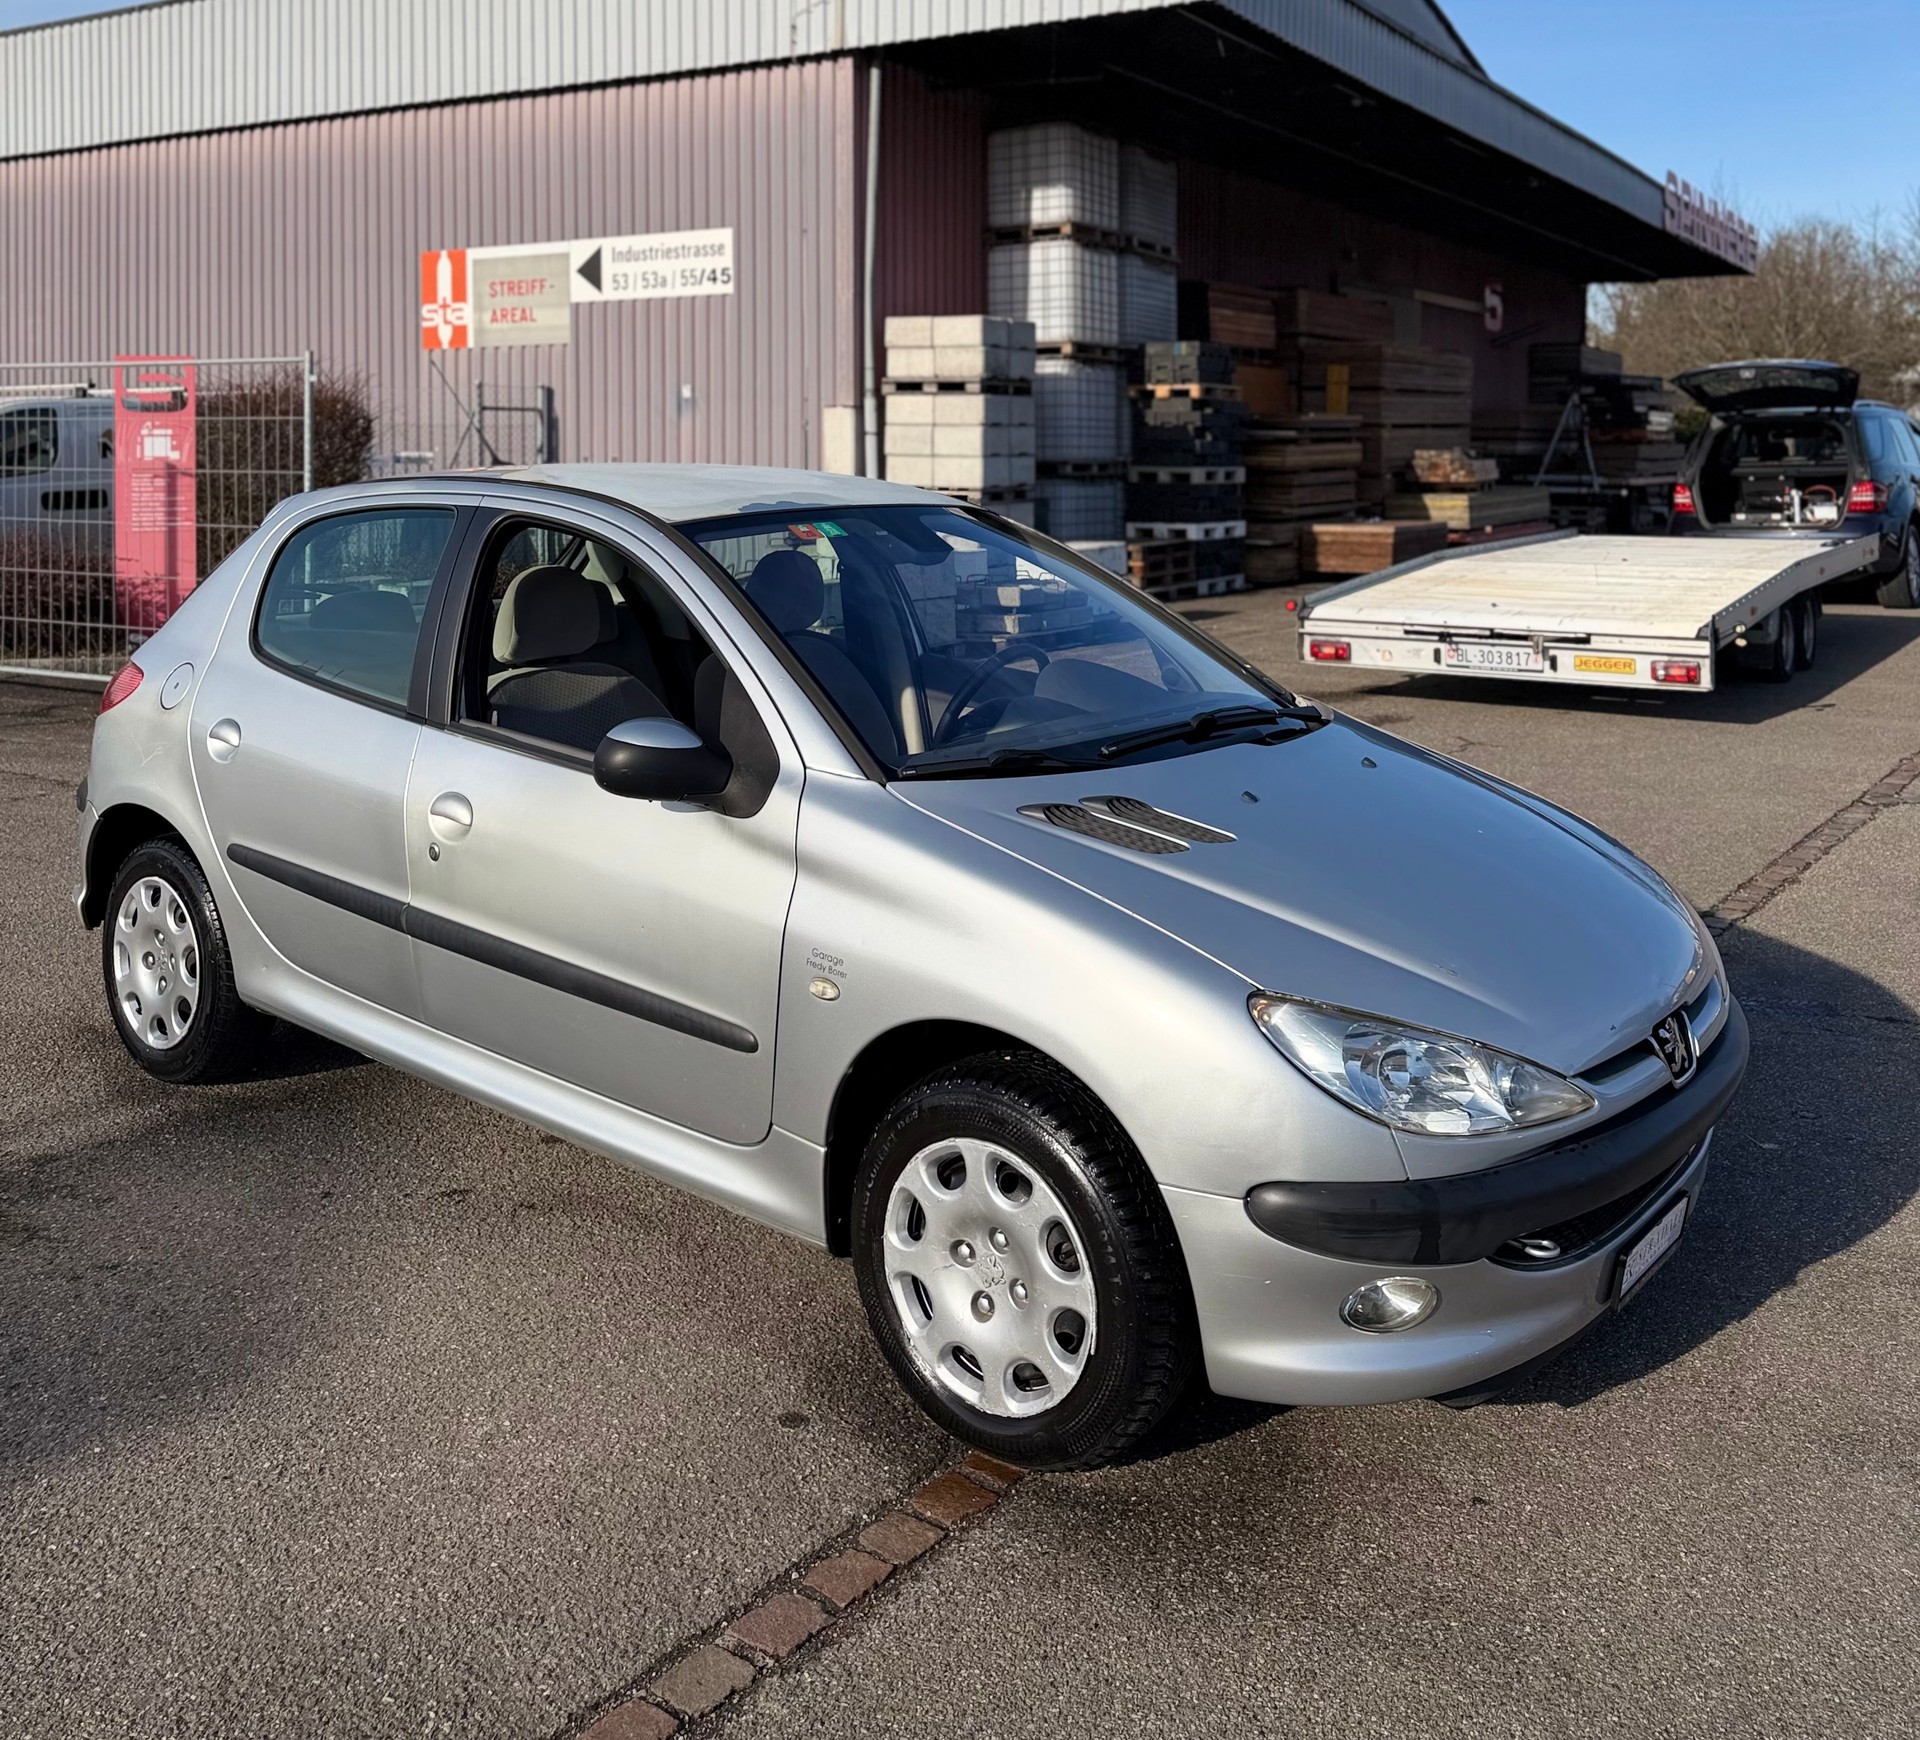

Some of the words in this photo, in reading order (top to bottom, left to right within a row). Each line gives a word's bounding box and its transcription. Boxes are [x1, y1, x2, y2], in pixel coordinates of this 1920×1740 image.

[611, 242, 726, 263] Industriestrasse
[612, 272, 629, 291] 53
[641, 270, 668, 289] 53a
[680, 267, 732, 287] 55/45
[421, 296, 468, 327] sta
[490, 306, 537, 325] AREAL
[1575, 658, 1633, 671] JEGGER
[806, 957, 827, 973] Fredy
[811, 947, 844, 966] Garage
